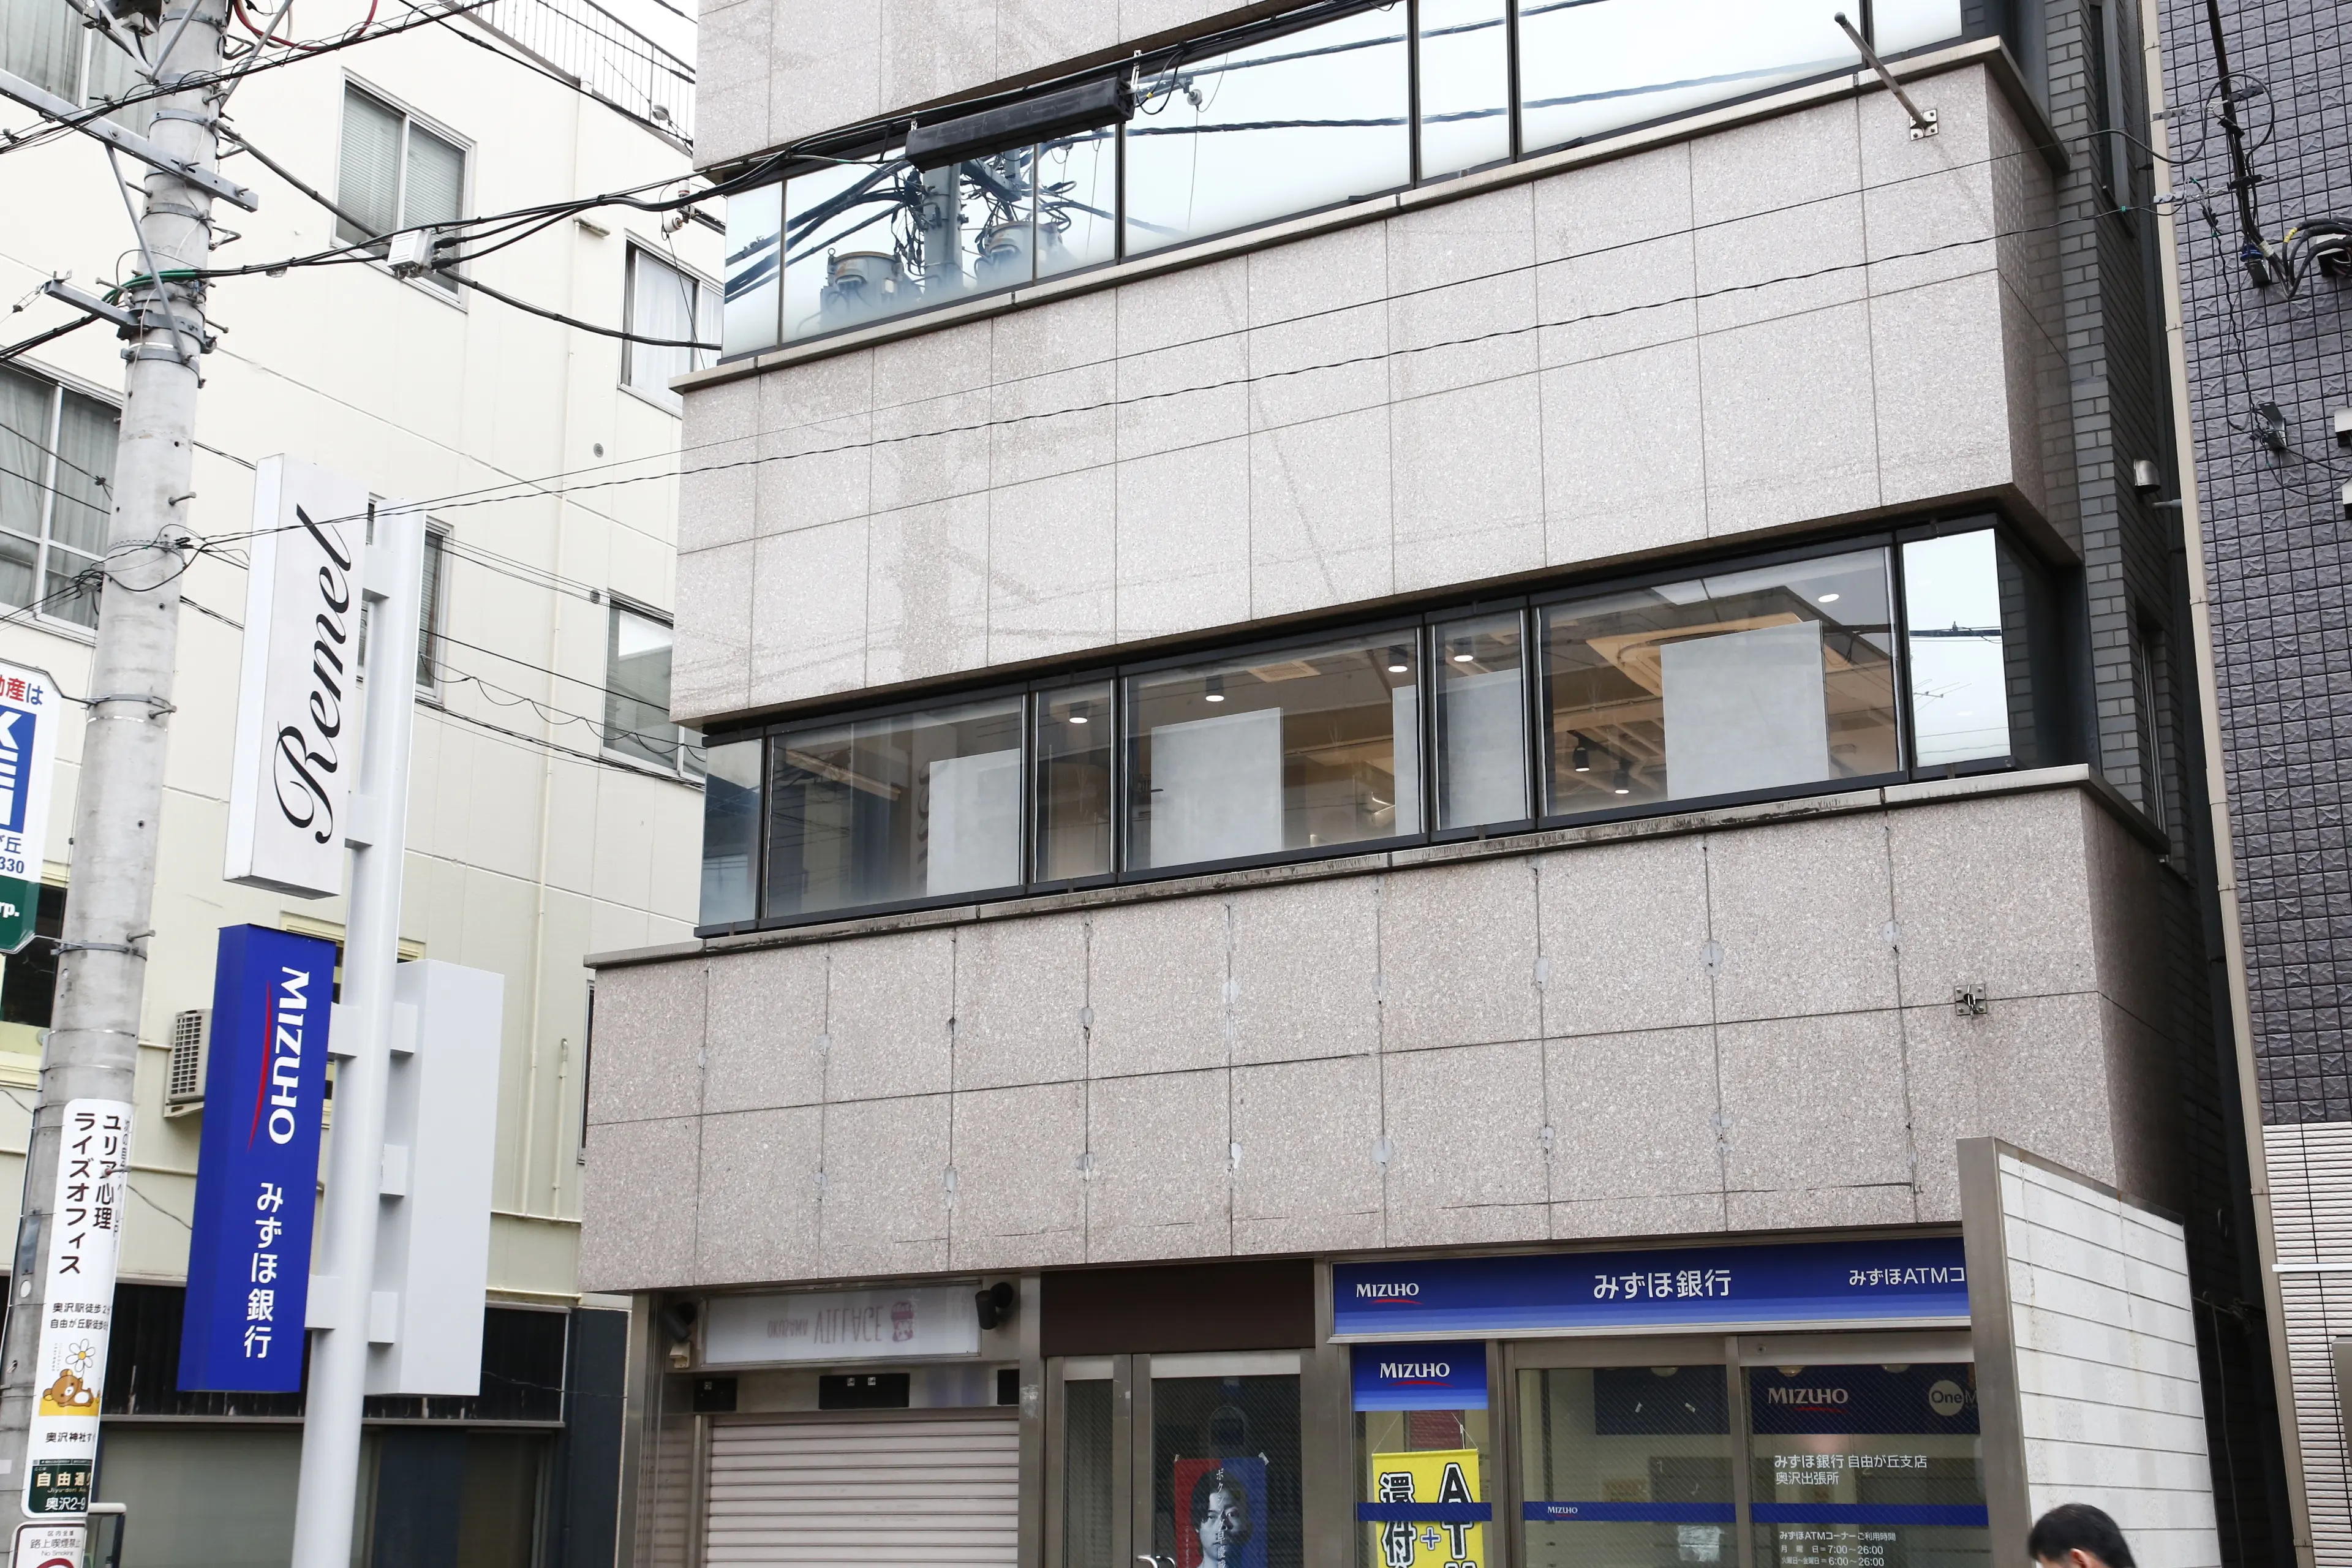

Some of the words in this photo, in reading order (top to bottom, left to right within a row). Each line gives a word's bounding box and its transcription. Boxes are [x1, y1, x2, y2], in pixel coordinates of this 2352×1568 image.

[274, 503, 352, 844] Remel
[268, 966, 309, 1145] MIZUHO
[59, 1112, 96, 1275] ライズオフィス
[244, 1182, 283, 1359] みずほ銀行
[1356, 1283, 1419, 1297] MIZUHO
[1594, 1269, 1732, 1299] みずほ銀行
[1380, 1363, 1450, 1378] MIZUHO
[1768, 1388, 1849, 1404] MIZUHO
[1774, 1455, 1844, 1469] みずほ銀行
[1848, 1455, 1927, 1469] 自由が丘支店
[1776, 1471, 1839, 1485] 奥沢出張所
